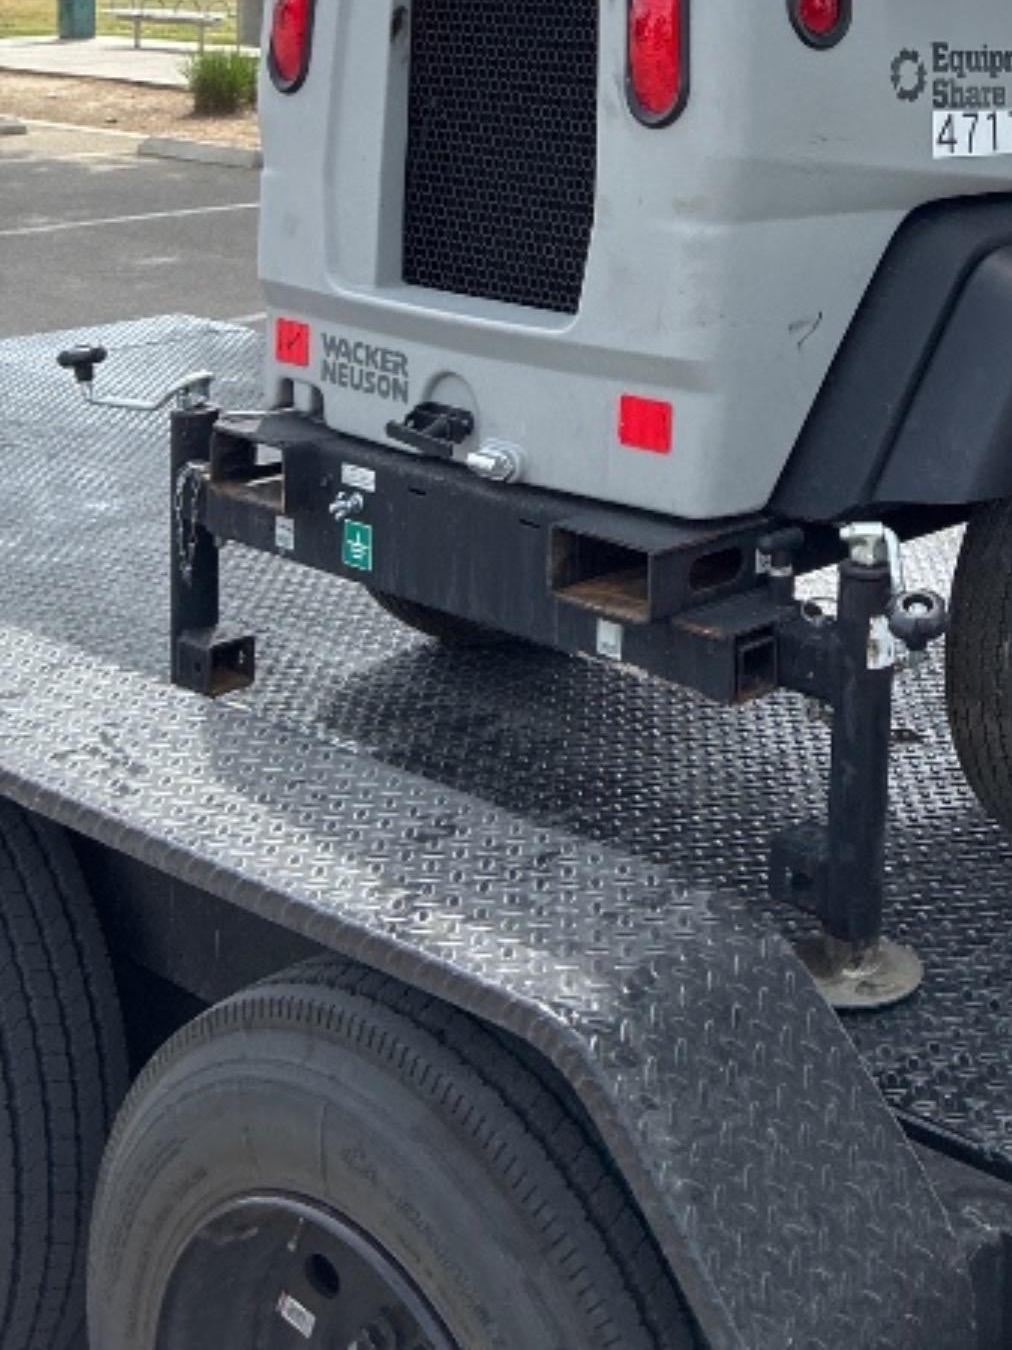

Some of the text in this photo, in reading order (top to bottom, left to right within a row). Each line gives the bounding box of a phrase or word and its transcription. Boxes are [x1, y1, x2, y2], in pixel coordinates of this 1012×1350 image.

[932, 78, 1006, 109] Share
[320, 332, 409, 379] WACKER
[320, 358, 409, 406] NEUSON
